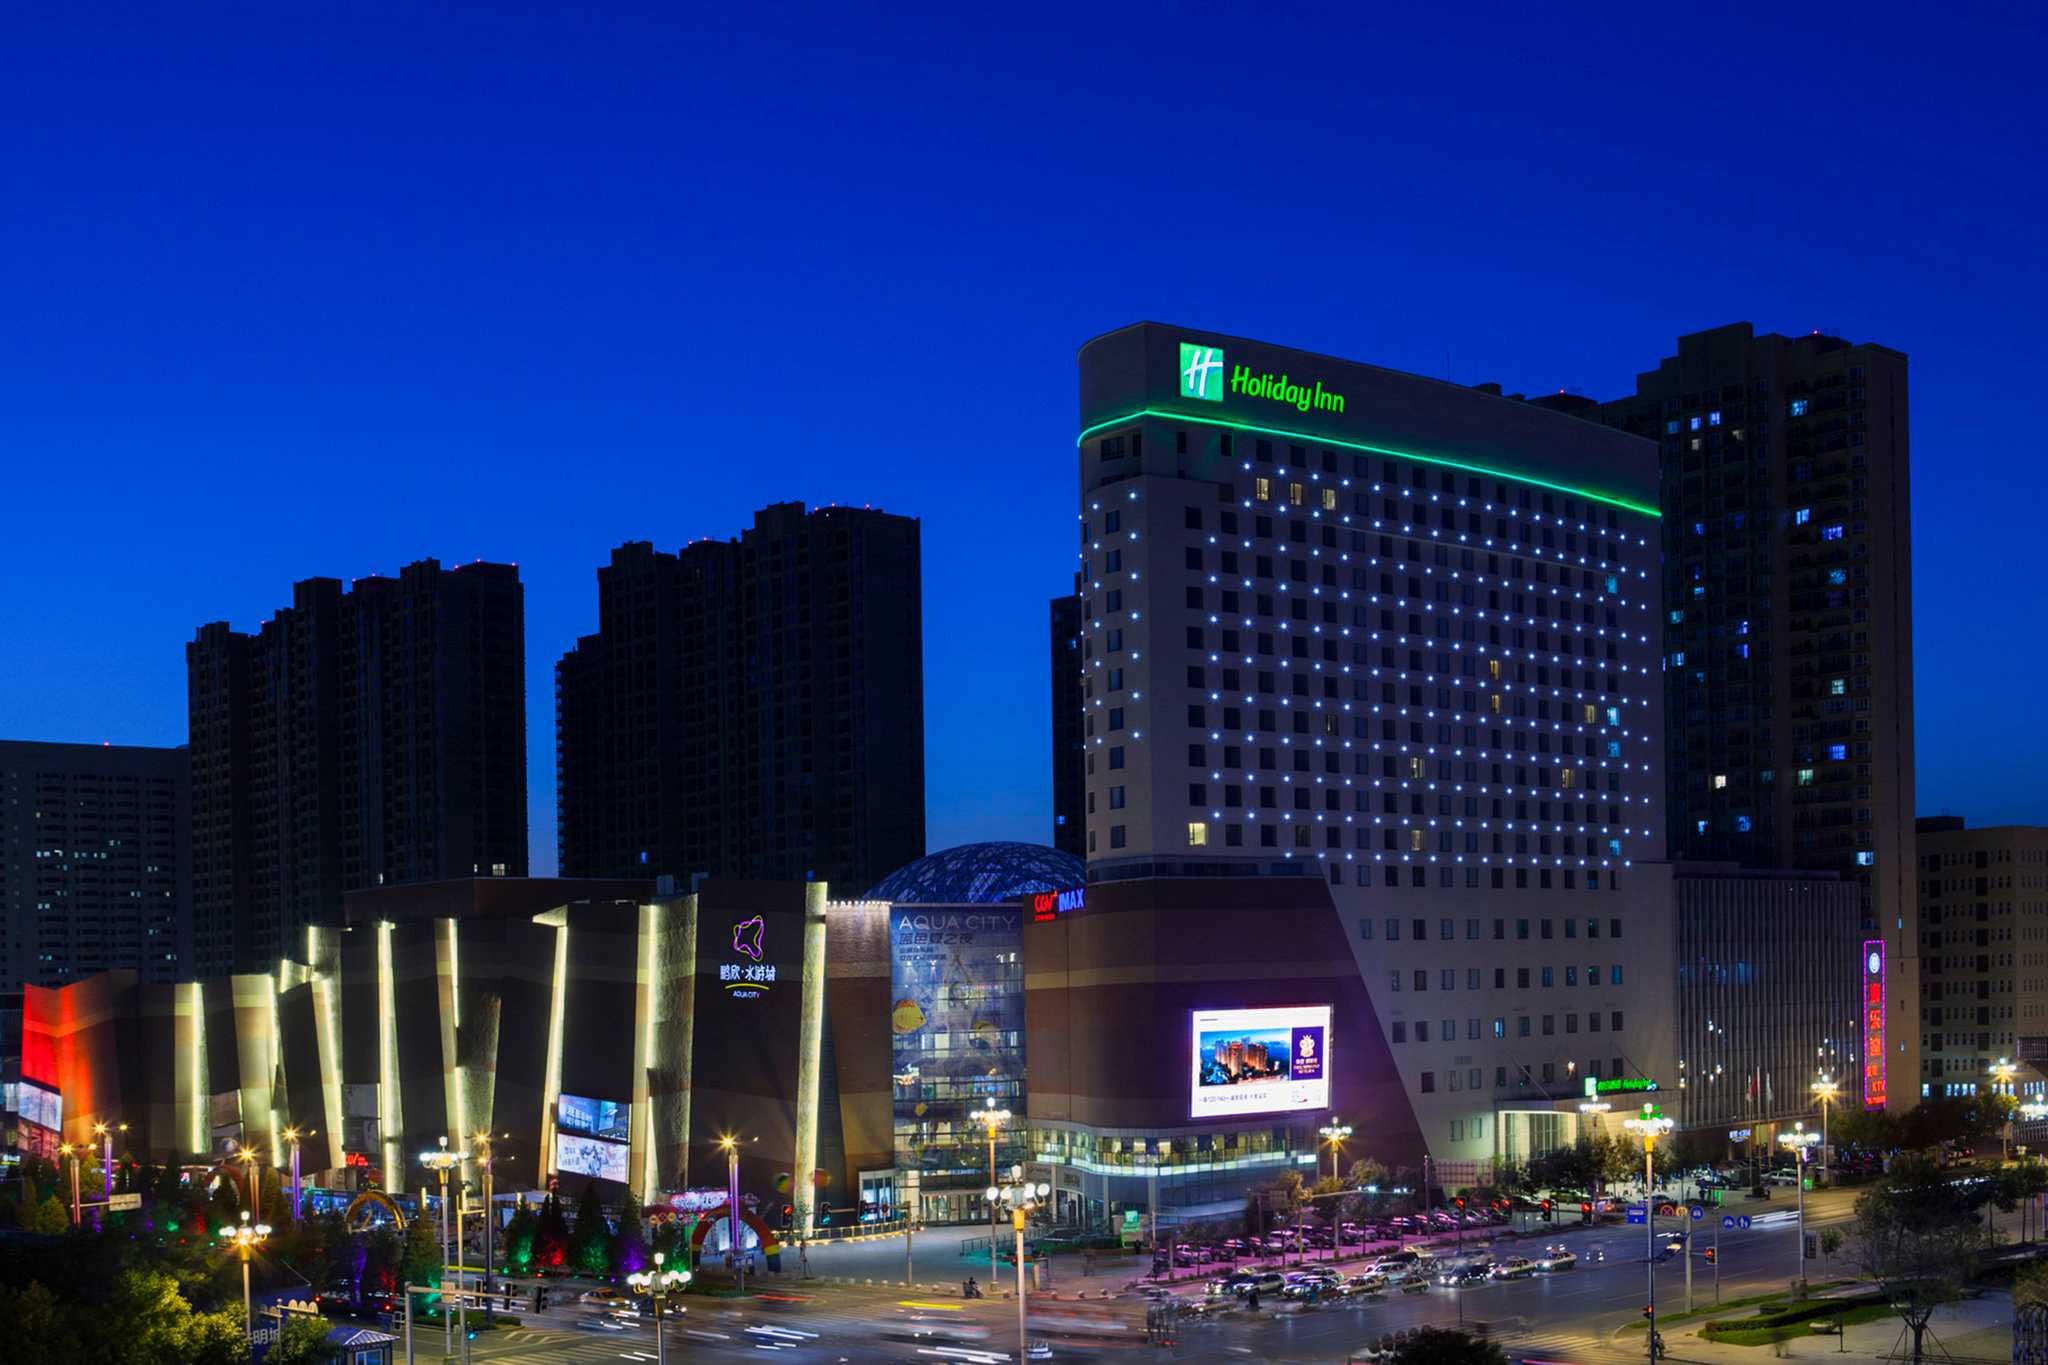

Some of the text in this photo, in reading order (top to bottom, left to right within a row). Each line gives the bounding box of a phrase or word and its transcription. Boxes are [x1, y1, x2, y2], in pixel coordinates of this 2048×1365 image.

[1230, 364, 1346, 413] Holiday Inn
[1058, 887, 1085, 913] IMAX
[899, 915, 960, 931] AQUA
[966, 915, 1017, 931] CITY
